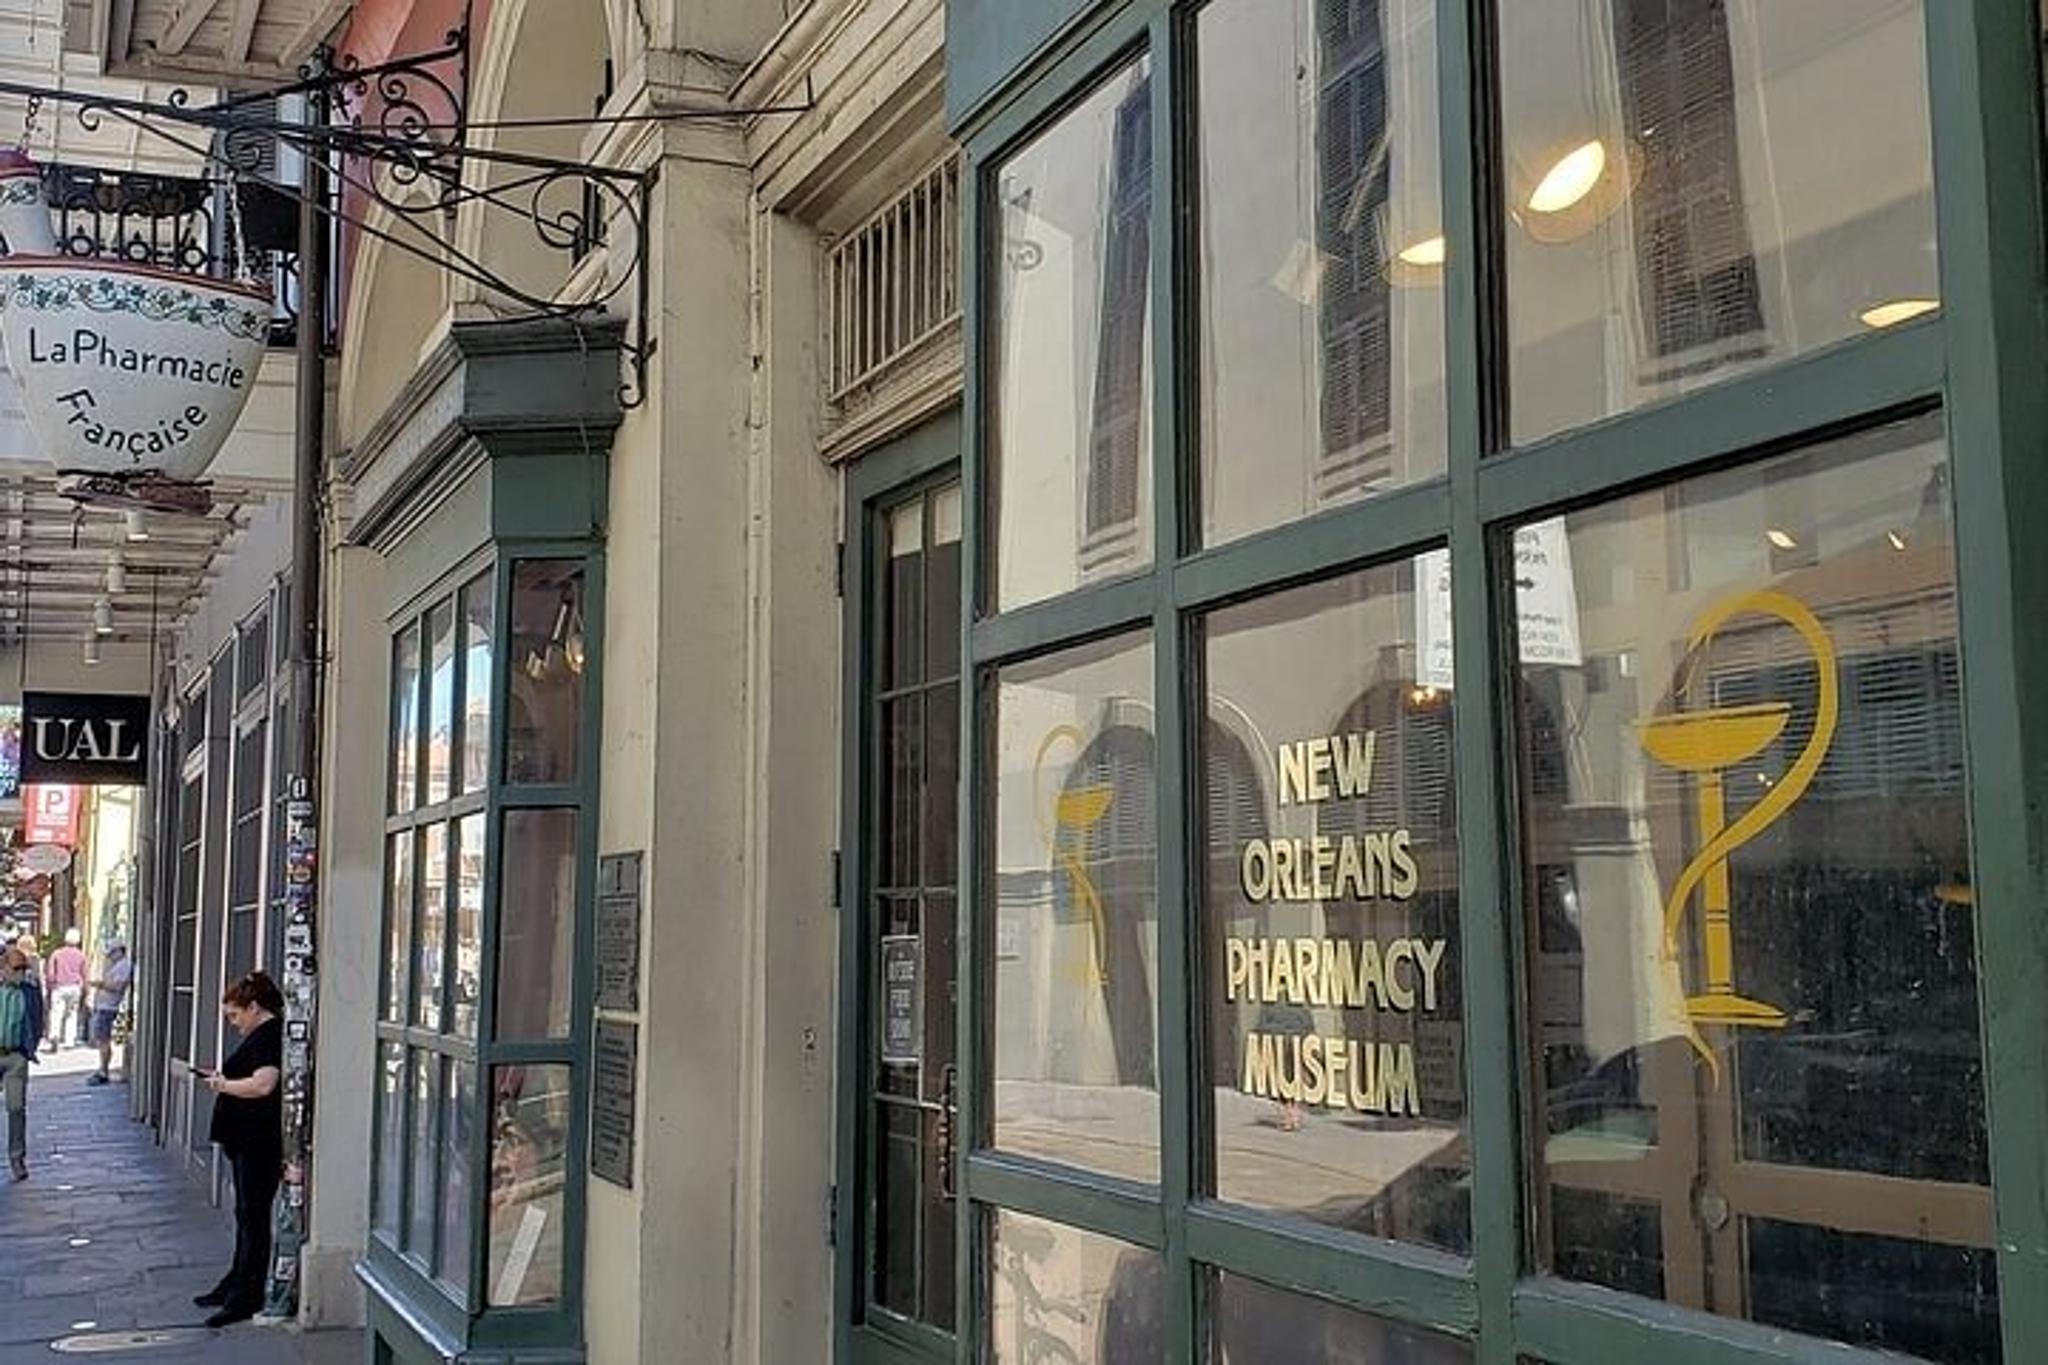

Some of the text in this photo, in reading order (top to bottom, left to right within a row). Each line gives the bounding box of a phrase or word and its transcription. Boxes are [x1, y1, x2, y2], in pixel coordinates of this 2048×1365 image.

[56, 388, 208, 463] Française
[33, 717, 140, 761] UAL
[1278, 731, 1376, 805] NEW
[1240, 829, 1419, 902] ORLEANS
[1225, 937, 1446, 1011] PHARMACY
[1242, 1032, 1421, 1115] MUSEUM
